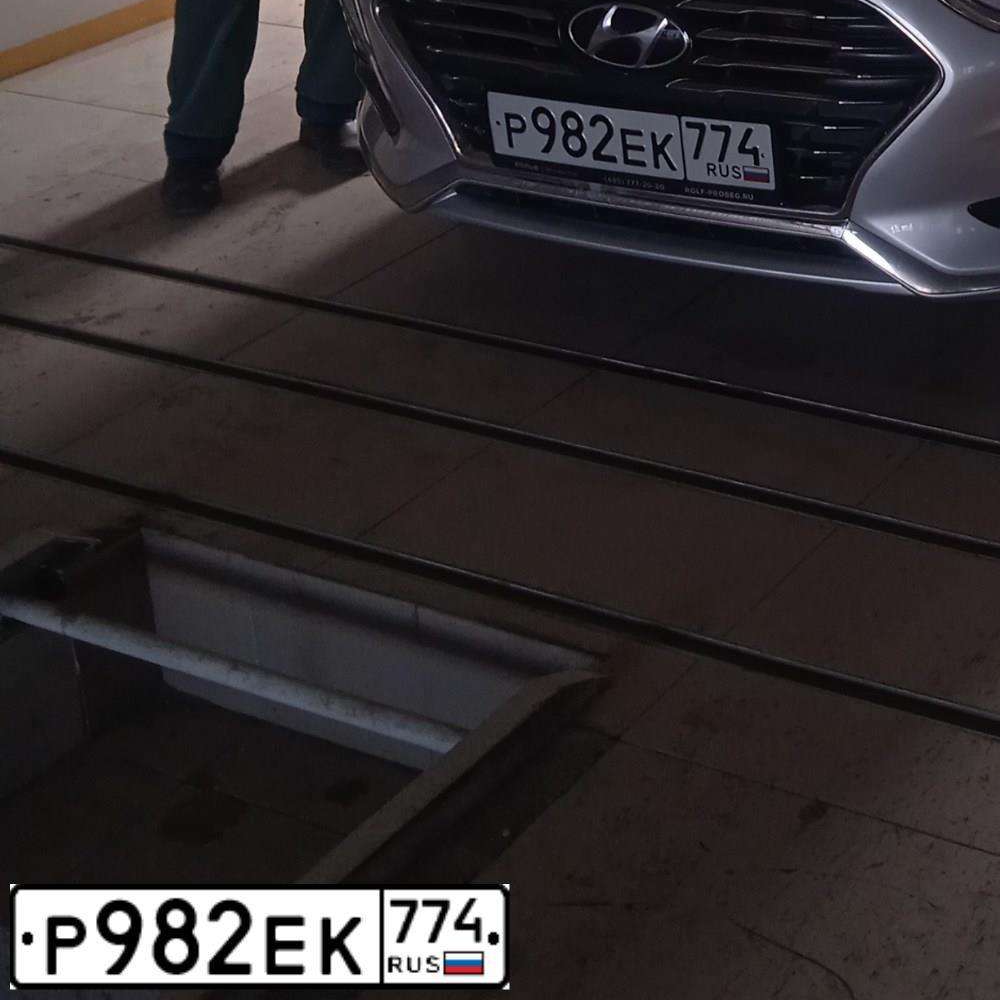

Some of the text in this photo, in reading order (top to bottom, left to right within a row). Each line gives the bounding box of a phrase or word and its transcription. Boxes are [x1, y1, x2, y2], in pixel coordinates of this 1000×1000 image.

[504, 106, 761, 172] Р982ЕК 774
[706, 162, 742, 180] RUS
